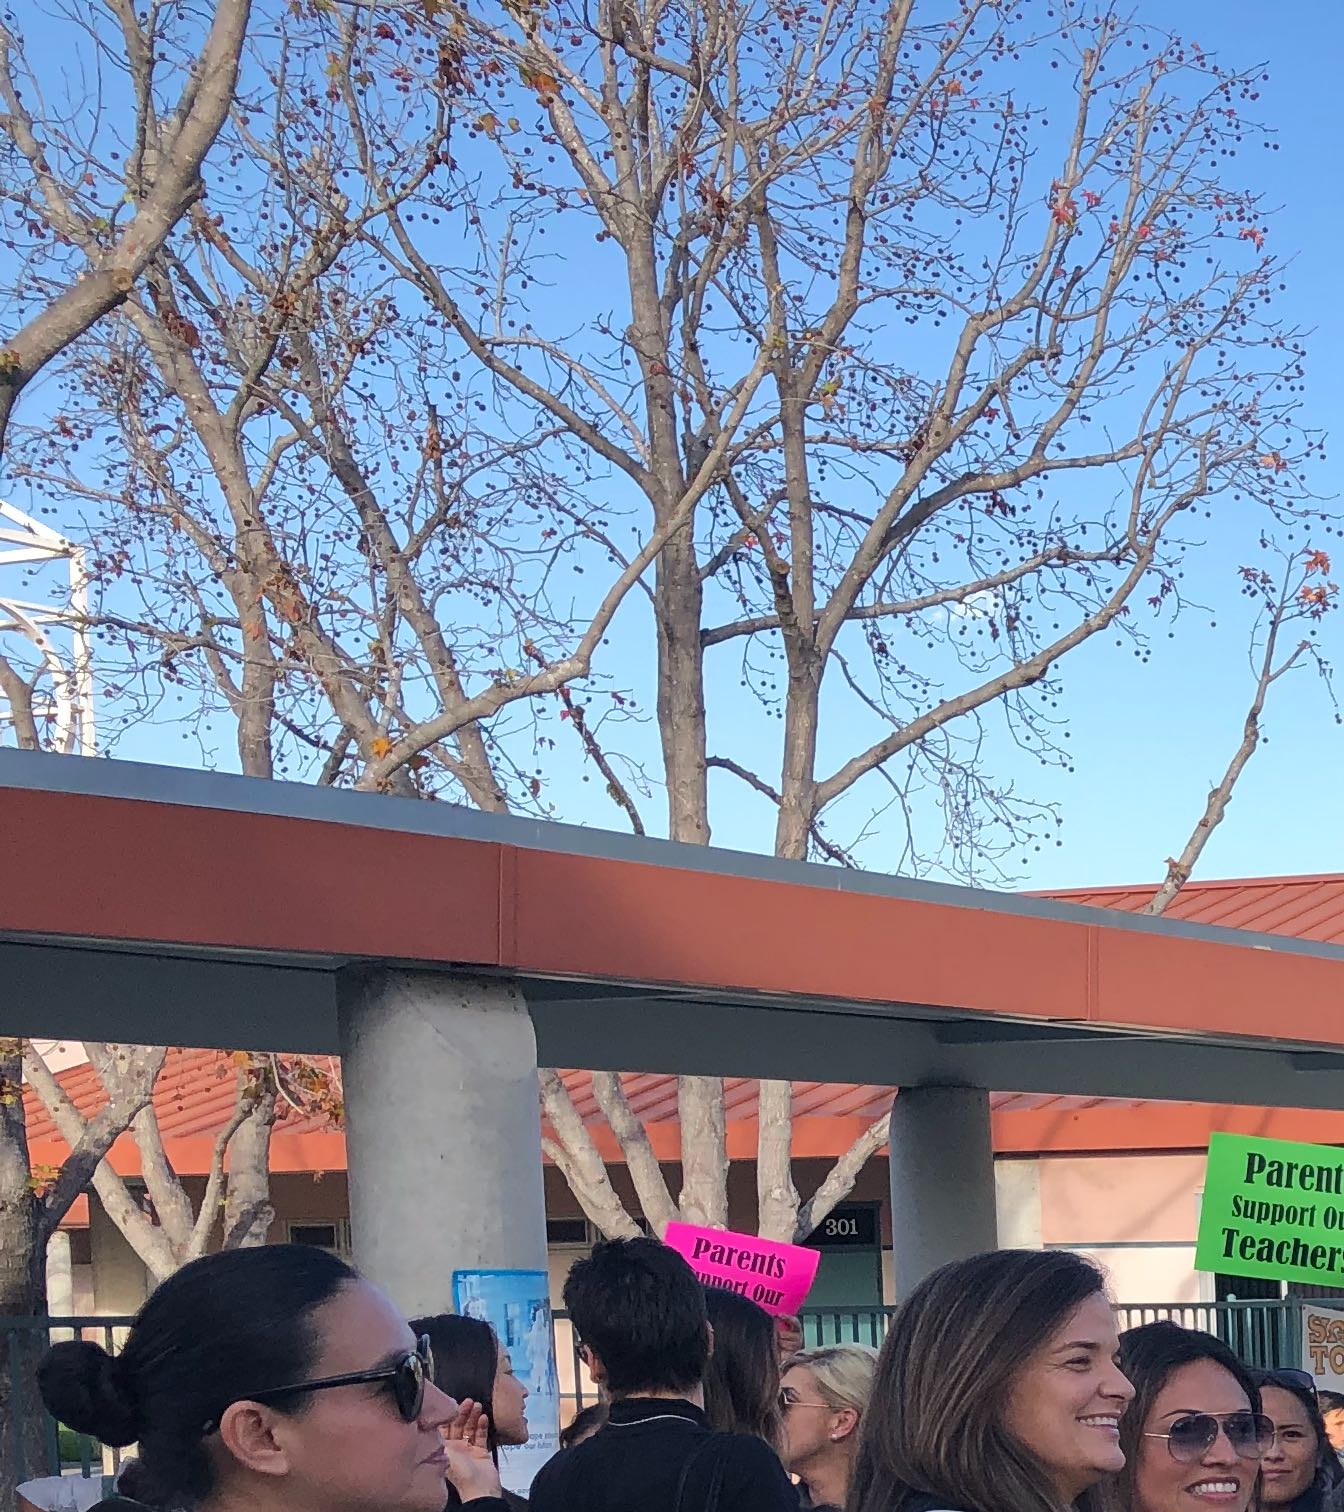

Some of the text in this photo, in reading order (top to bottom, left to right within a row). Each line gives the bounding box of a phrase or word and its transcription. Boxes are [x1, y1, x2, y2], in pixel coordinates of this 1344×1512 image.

[1232, 1195, 1317, 1227] Support
[825, 1218, 859, 1236] 301
[692, 1237, 786, 1279] Parents
[753, 1283, 785, 1306] Our
